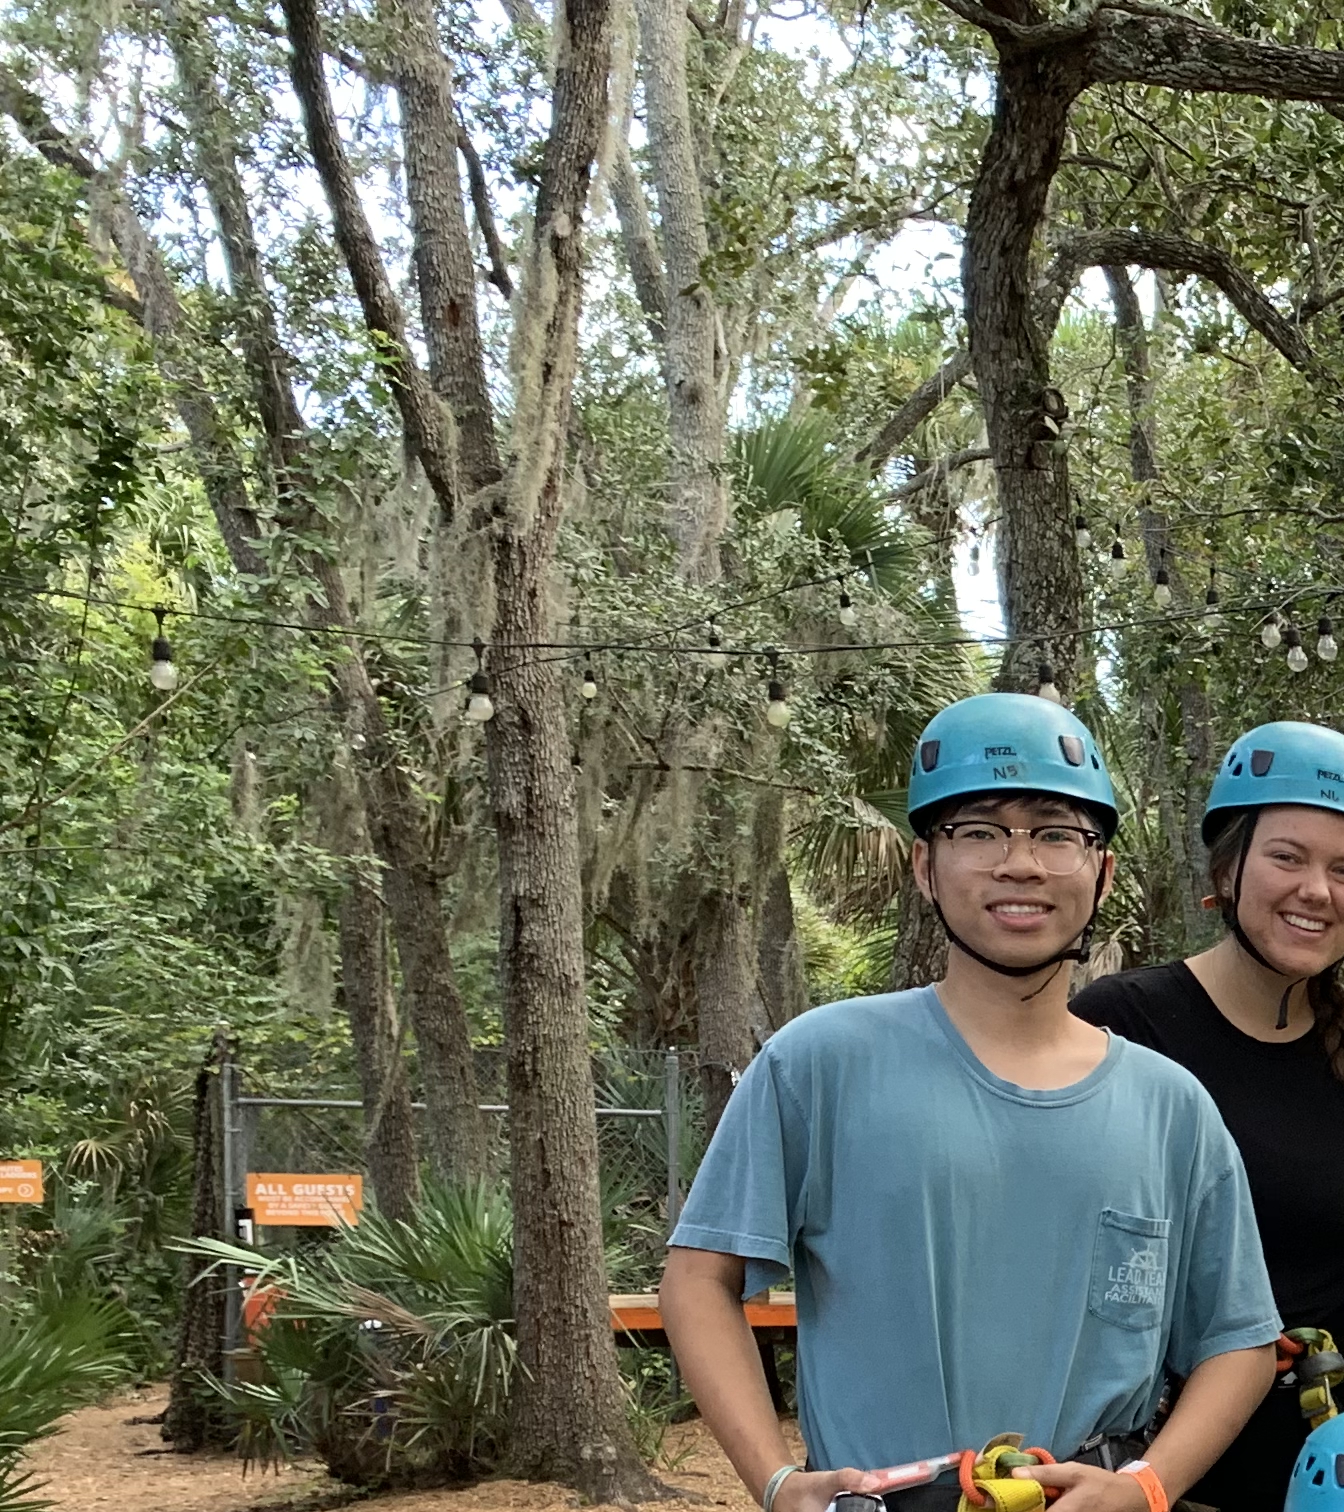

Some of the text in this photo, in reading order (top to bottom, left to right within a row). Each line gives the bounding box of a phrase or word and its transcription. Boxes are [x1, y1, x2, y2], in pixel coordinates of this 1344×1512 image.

[993, 764, 1018, 780] N5
[255, 1183, 355, 1196] ALL GUESTS
[1108, 1266, 1142, 1285] LEAD
